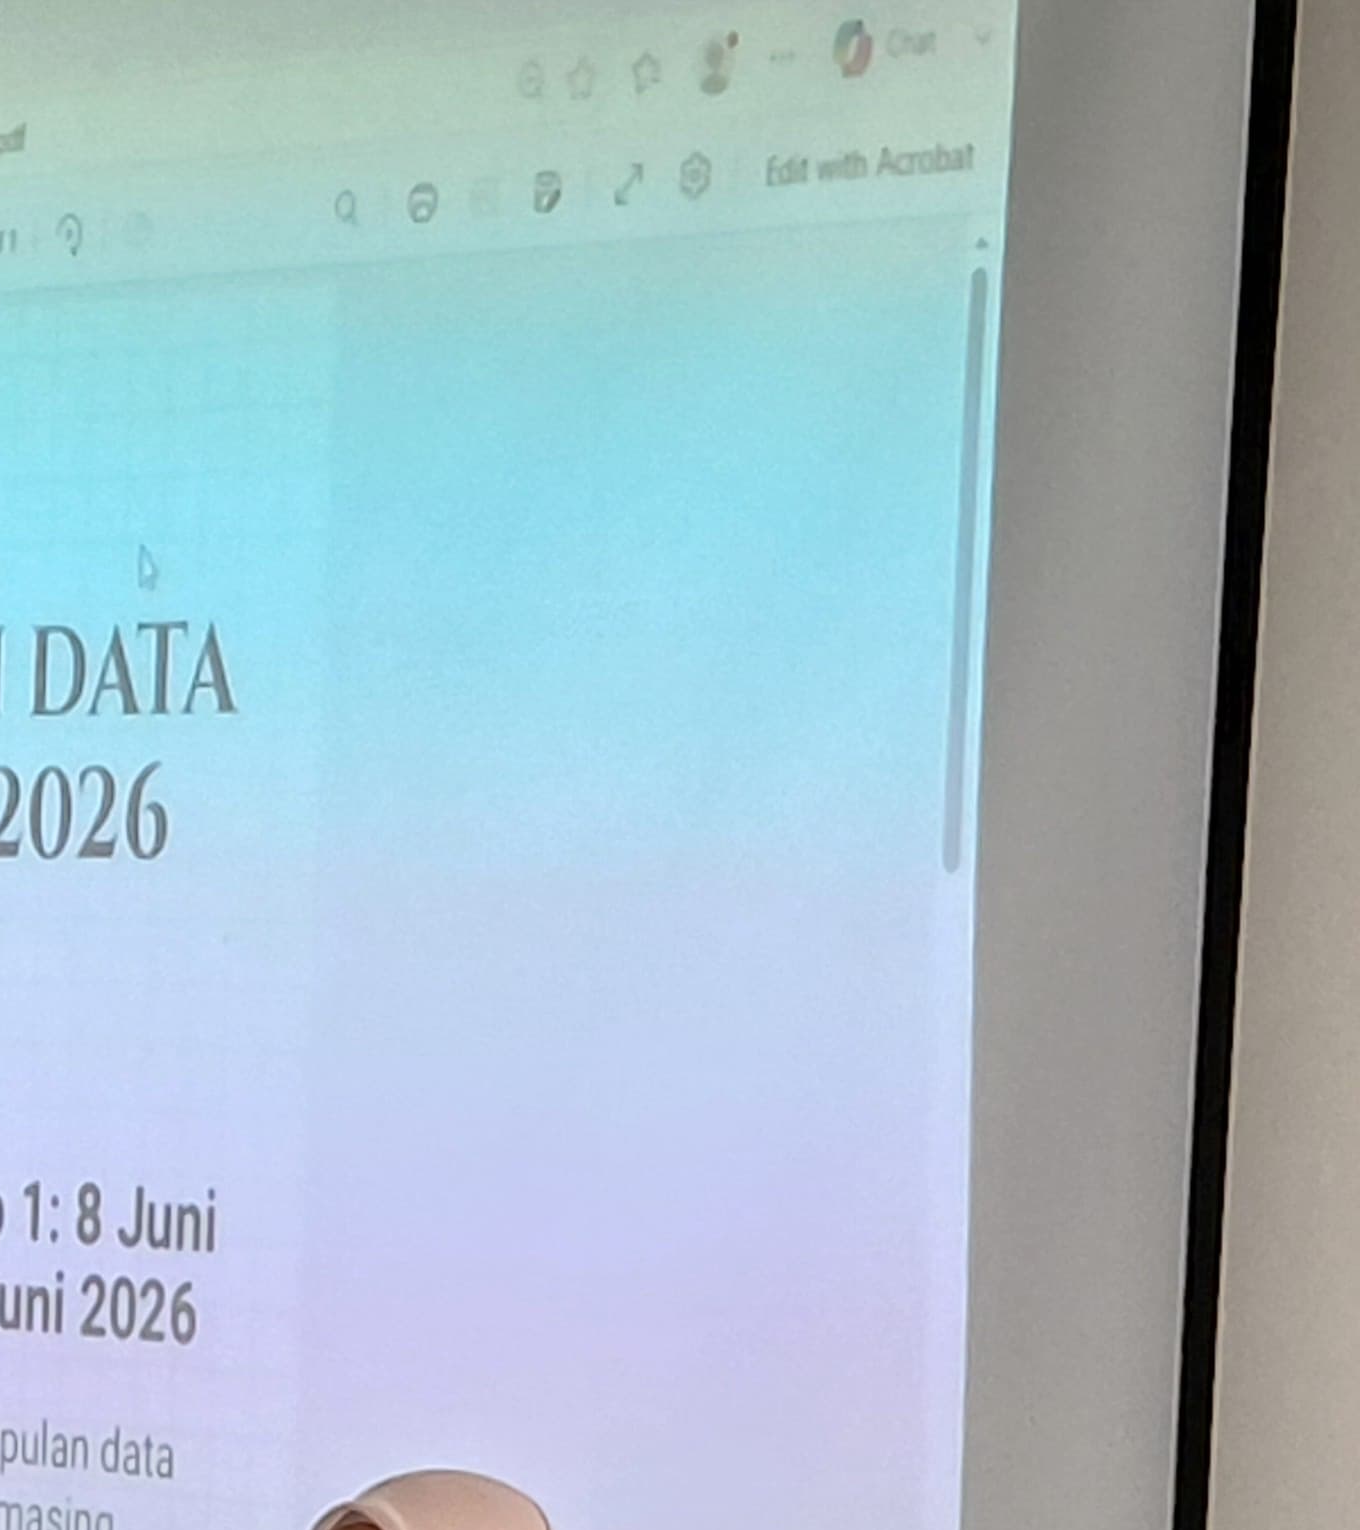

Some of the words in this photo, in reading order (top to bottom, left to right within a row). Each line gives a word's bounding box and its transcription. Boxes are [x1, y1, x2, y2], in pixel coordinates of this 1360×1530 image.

[766, 154, 808, 186] Edit
[817, 150, 868, 181] with
[876, 142, 975, 176] Acrobat
[30, 620, 239, 719] DATA
[23, 1180, 60, 1244] 1:
[76, 1182, 102, 1245] 8
[118, 1186, 217, 1253] Juni
[80, 1273, 198, 1345] 2026
[100, 1426, 175, 1480] data
